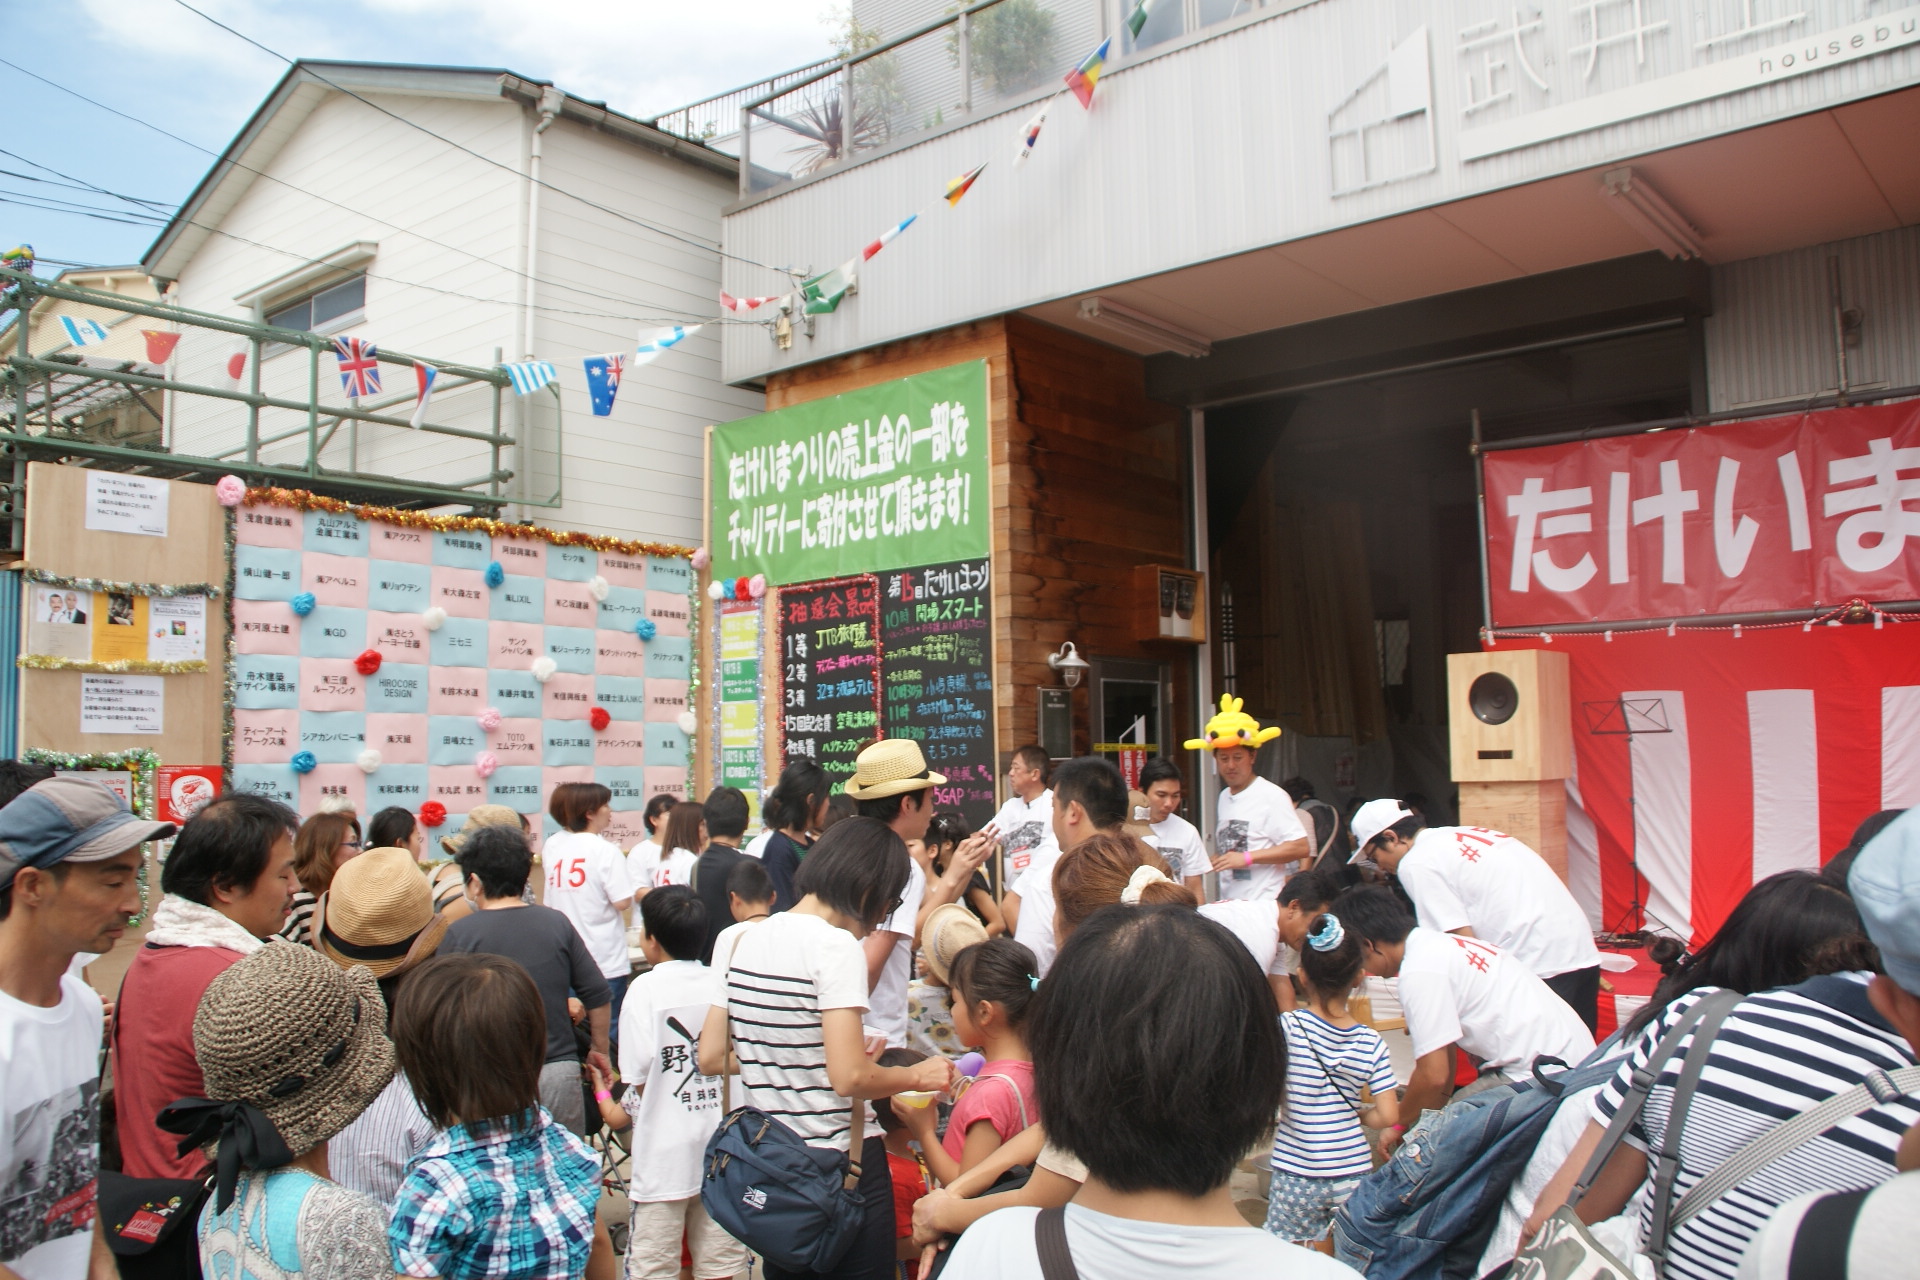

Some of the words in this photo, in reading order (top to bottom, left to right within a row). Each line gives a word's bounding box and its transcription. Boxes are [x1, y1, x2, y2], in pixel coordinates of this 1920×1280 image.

[728, 400, 970, 500] たけいまつりの売上金の一部を
[1507, 437, 1920, 593] たけいま
[785, 632, 808, 659] 1等
[785, 662, 808, 683] 2等
[379, 678, 418, 689] HIROCORE
[384, 688, 412, 698] DESIGN
[785, 688, 806, 708] 3等
[506, 733, 526, 742] TOTO
[927, 743, 968, 759] もちつき
[661, 1045, 689, 1074] 野
